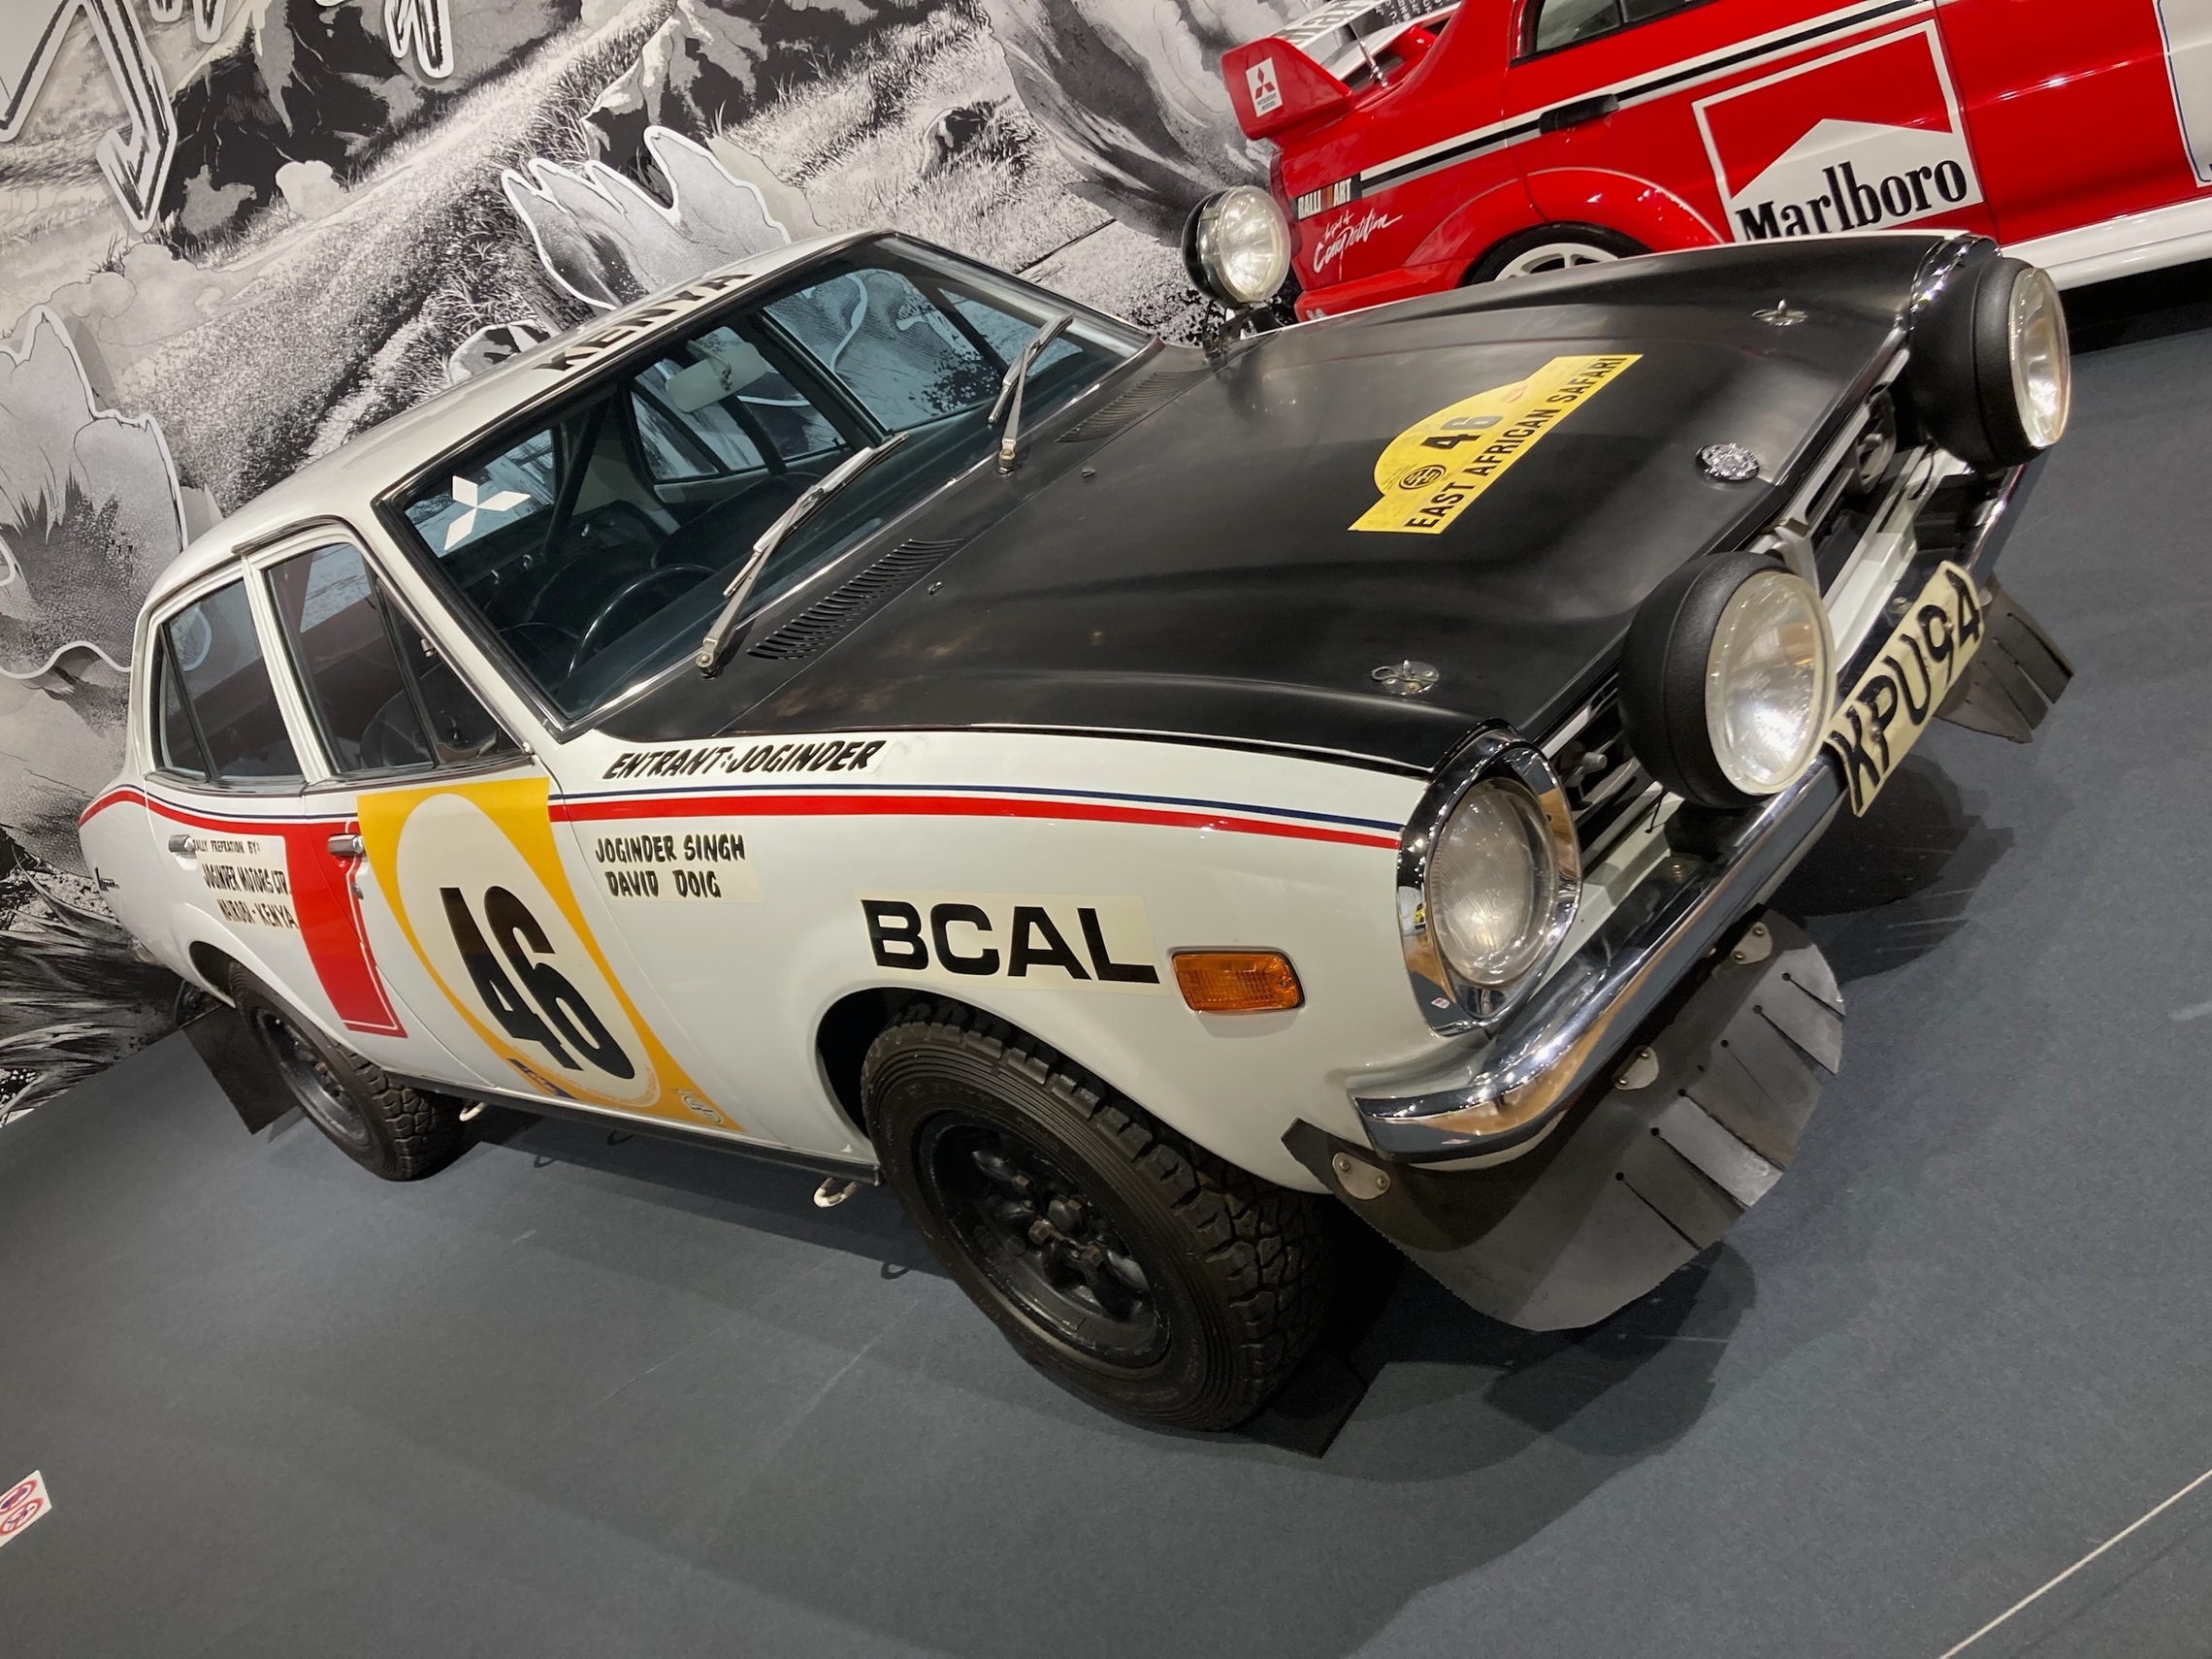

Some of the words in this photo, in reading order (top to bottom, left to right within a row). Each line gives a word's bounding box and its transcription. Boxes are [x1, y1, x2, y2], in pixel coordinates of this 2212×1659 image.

[1735, 160, 1968, 242] Marlboro
[531, 274, 754, 372] KENYA
[1404, 482, 1476, 528] EAST
[1462, 408, 1562, 476] AFRICAN
[1546, 357, 1629, 403] SAFARI
[1419, 415, 1504, 450] 46
[237, 865, 275, 894] MOTORS
[595, 835, 677, 863] JOGINDER
[683, 833, 745, 862] SINGH
[604, 870, 660, 897] DAVID
[671, 869, 722, 898] DOIG
[439, 885, 635, 1080] 46
[860, 898, 1160, 985] BCAL
